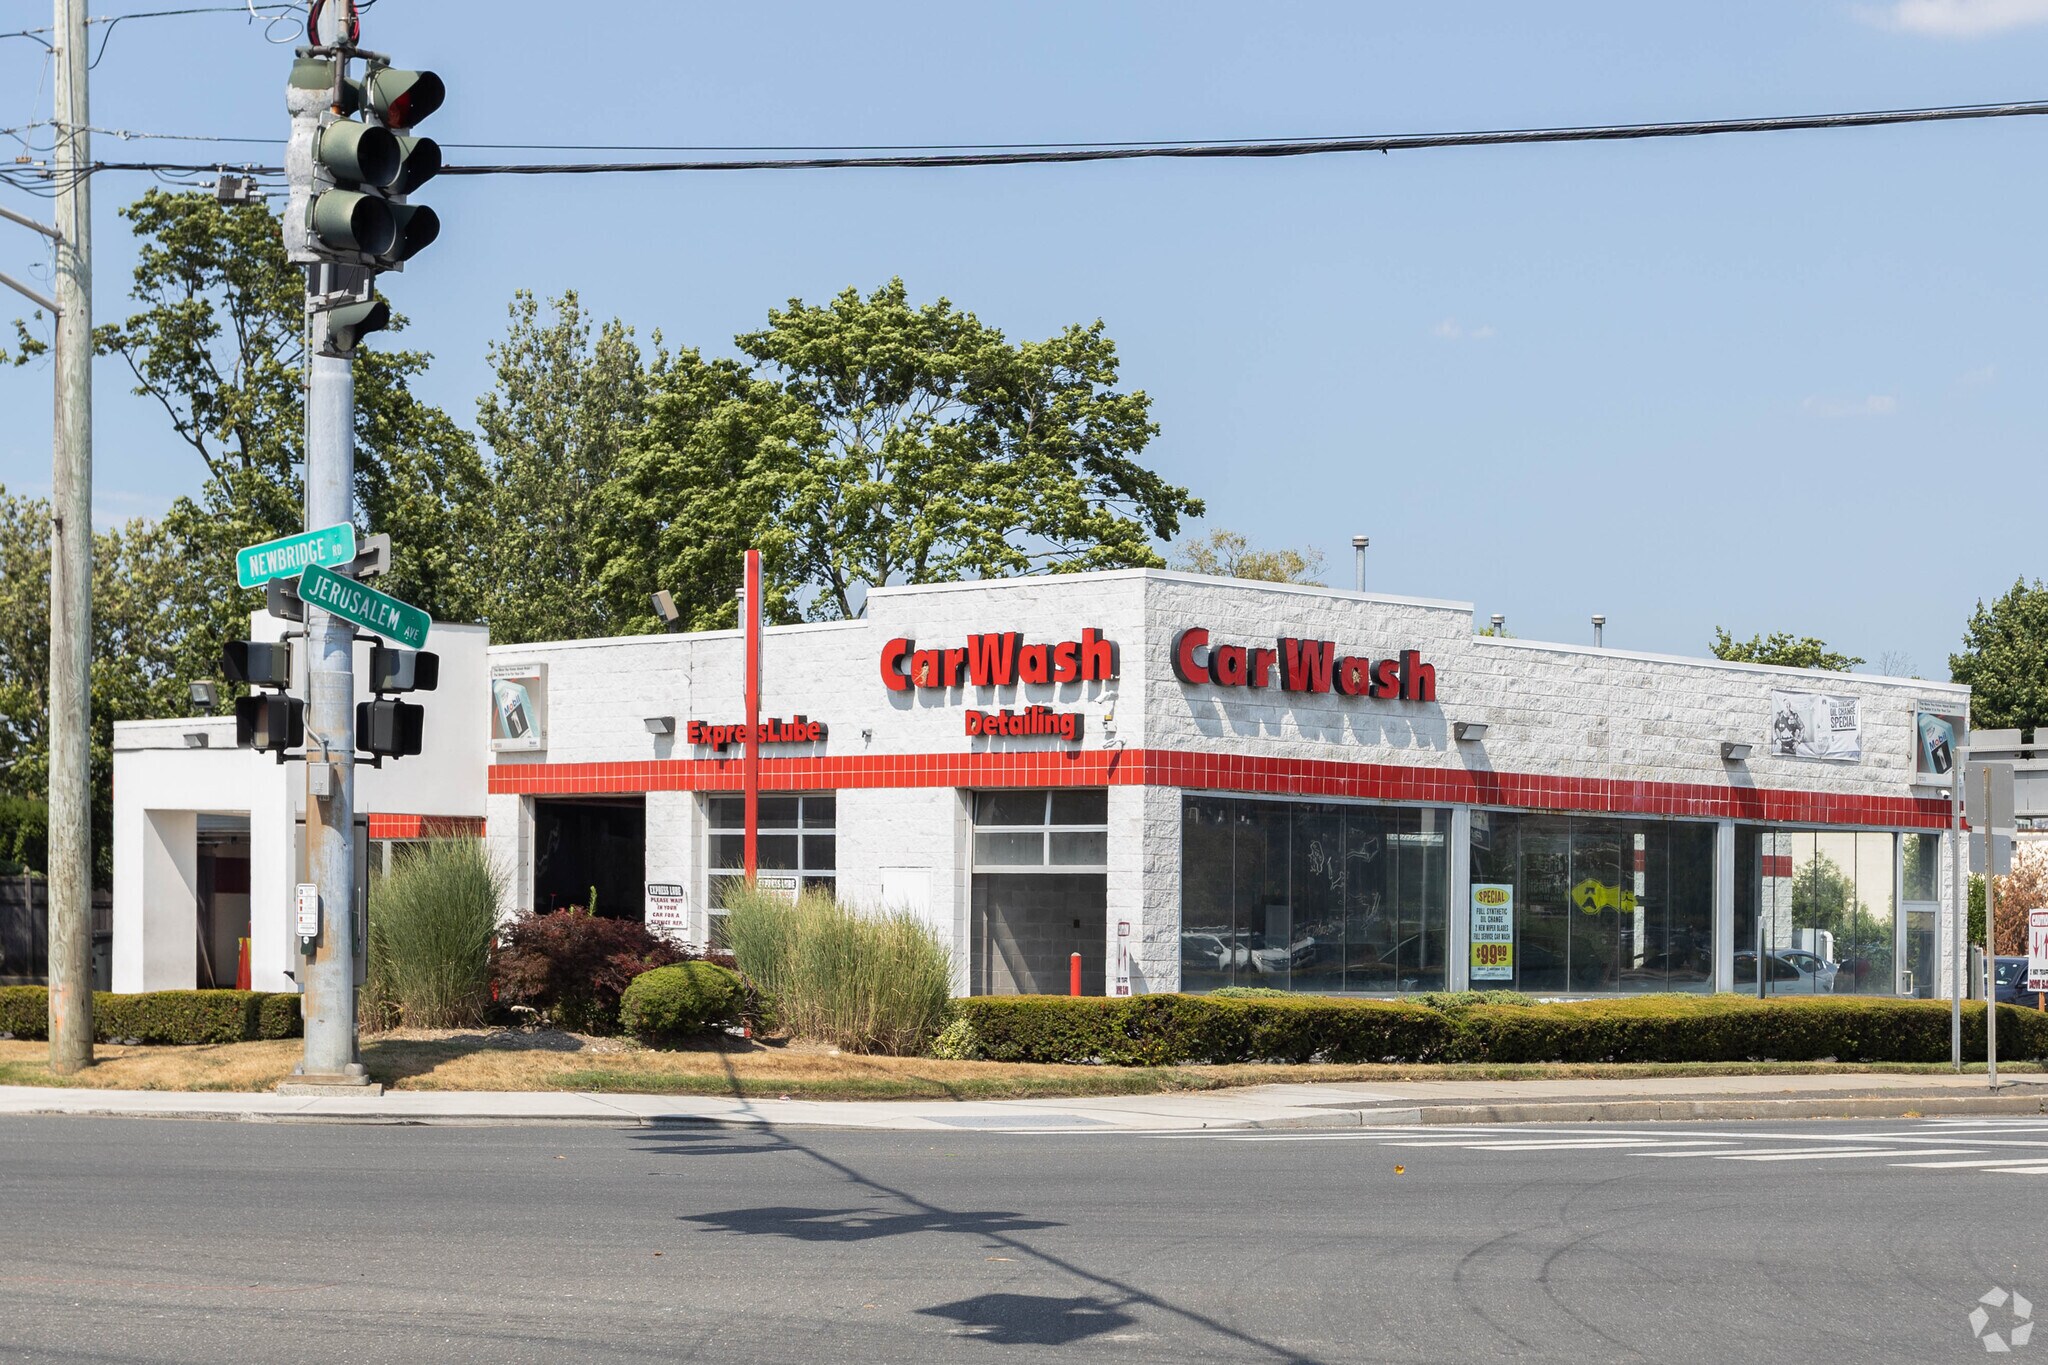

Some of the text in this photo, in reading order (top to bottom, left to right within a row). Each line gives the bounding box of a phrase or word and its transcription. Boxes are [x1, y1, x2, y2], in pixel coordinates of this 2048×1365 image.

[249, 538, 343, 578] NEWBRIDGE RD
[308, 575, 420, 641] JERUSALEM AVE
[504, 694, 521, 716] Mobil
[965, 705, 1081, 741] Detailing
[1830, 716, 1856, 728] SPECIAL
[687, 715, 824, 753] ExpresLube
[1929, 731, 1947, 751] Mobil
[1478, 890, 1505, 904] SPECIAL
[1476, 907, 1508, 915] FULL SYNTHETIC
